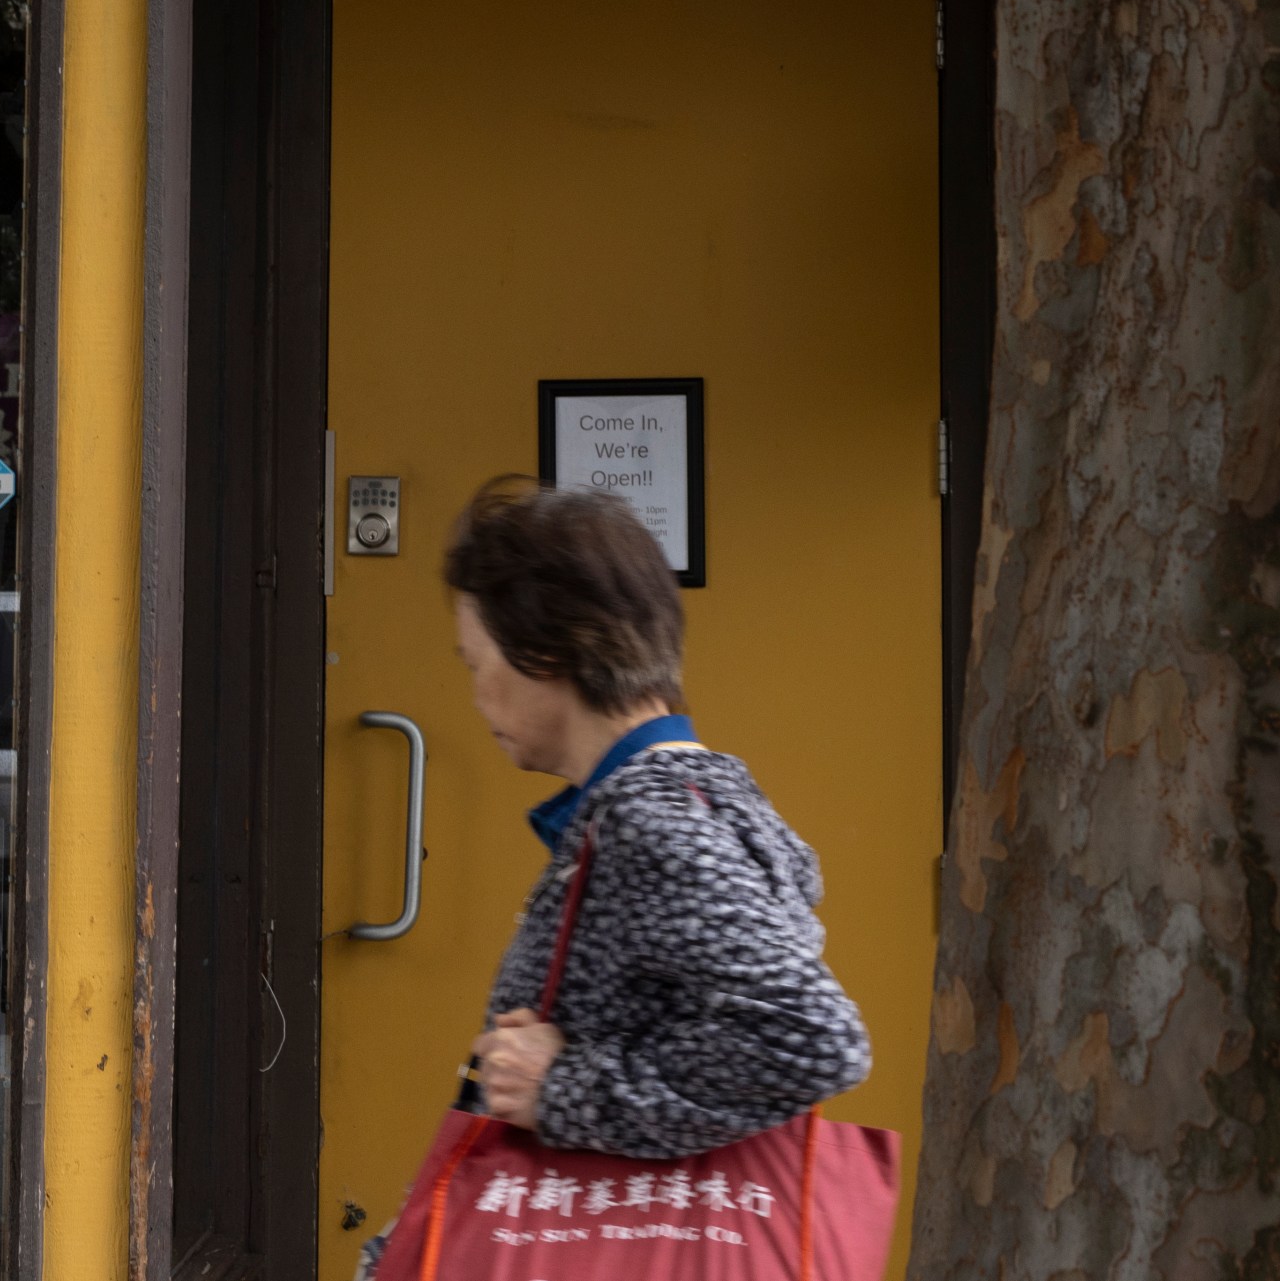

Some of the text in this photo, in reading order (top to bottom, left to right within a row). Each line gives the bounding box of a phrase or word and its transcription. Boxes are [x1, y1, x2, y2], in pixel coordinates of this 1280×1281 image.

[580, 415, 663, 432] Come In,
[595, 443, 648, 458] We're
[591, 470, 652, 489] Open!!
